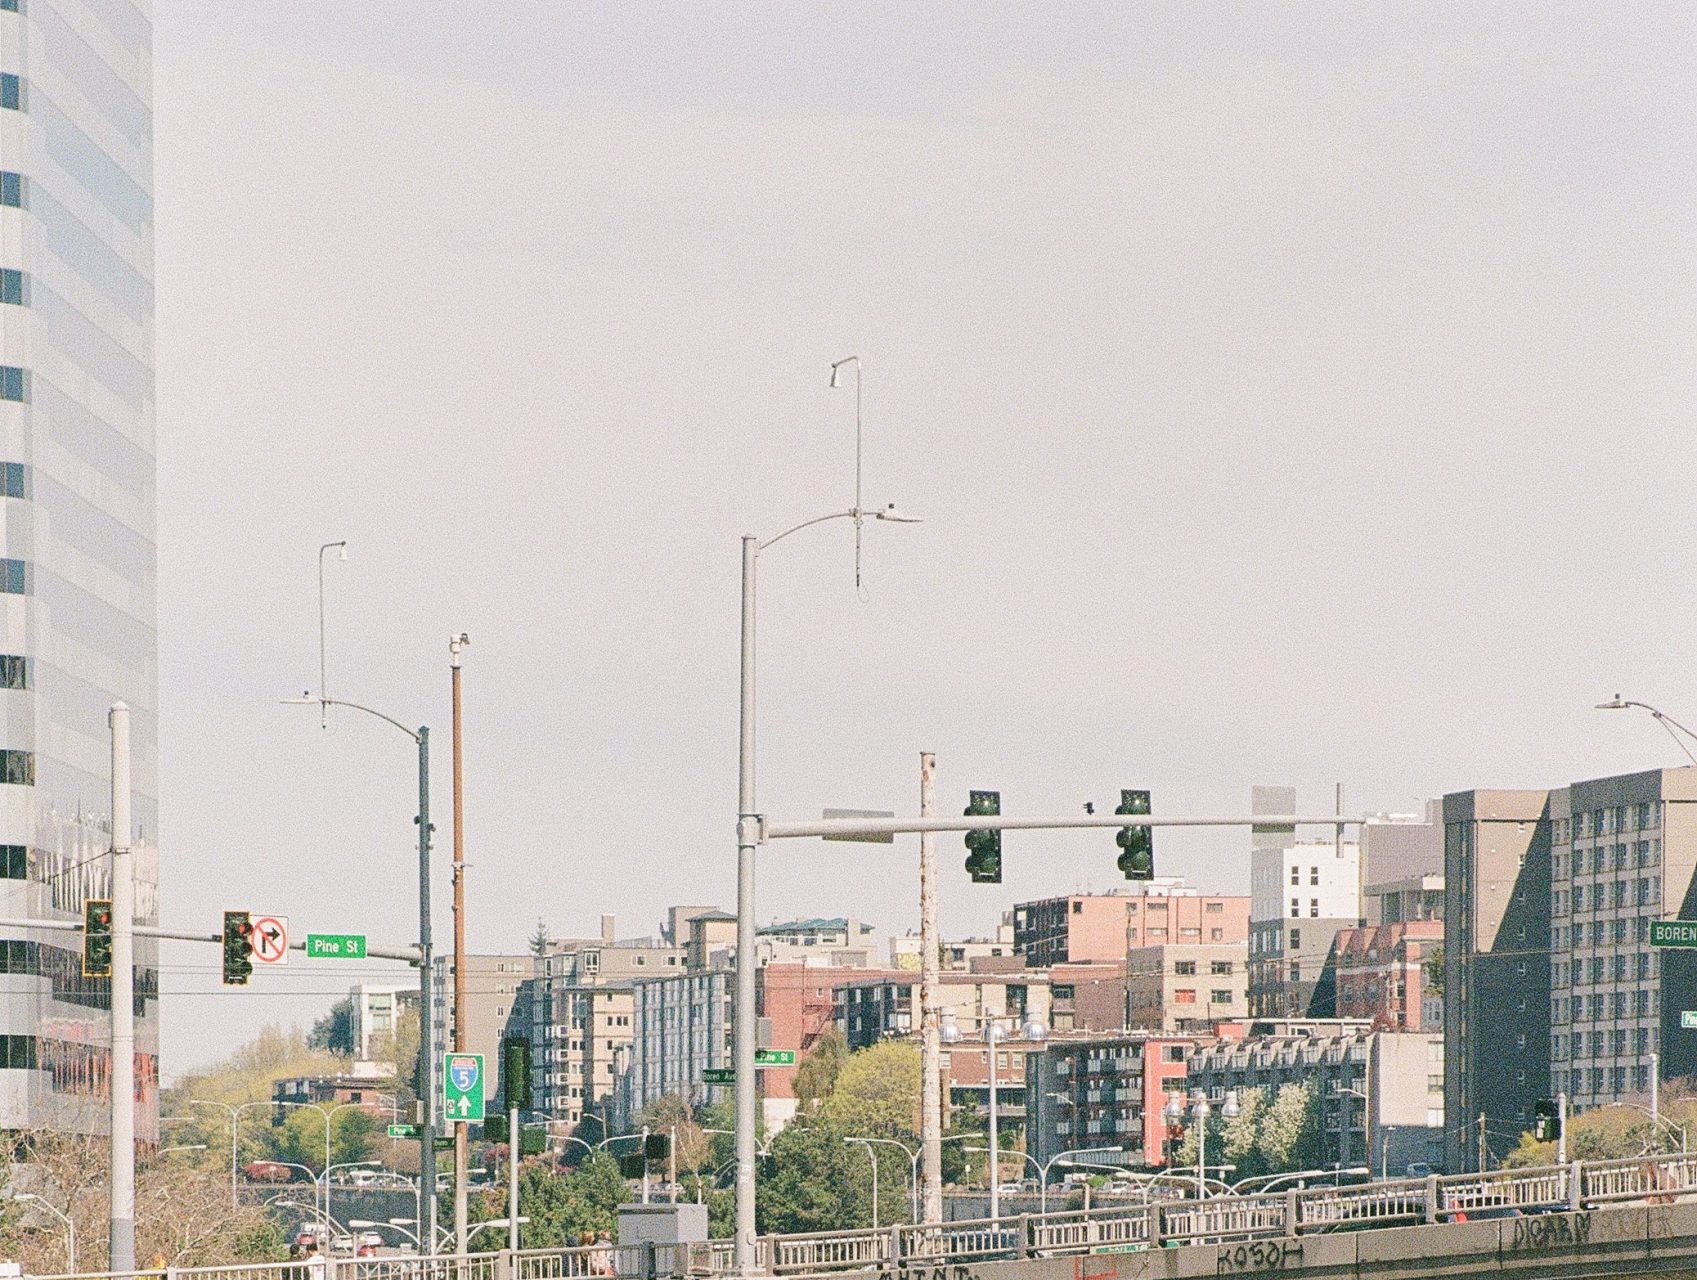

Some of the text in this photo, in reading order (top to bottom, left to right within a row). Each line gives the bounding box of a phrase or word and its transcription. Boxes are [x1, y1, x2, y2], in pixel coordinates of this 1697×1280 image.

[1656, 926, 1697, 940] BOREN
[314, 939, 359, 953] Pine St
[780, 1052, 788, 1061] St
[460, 1070, 469, 1088] 5
